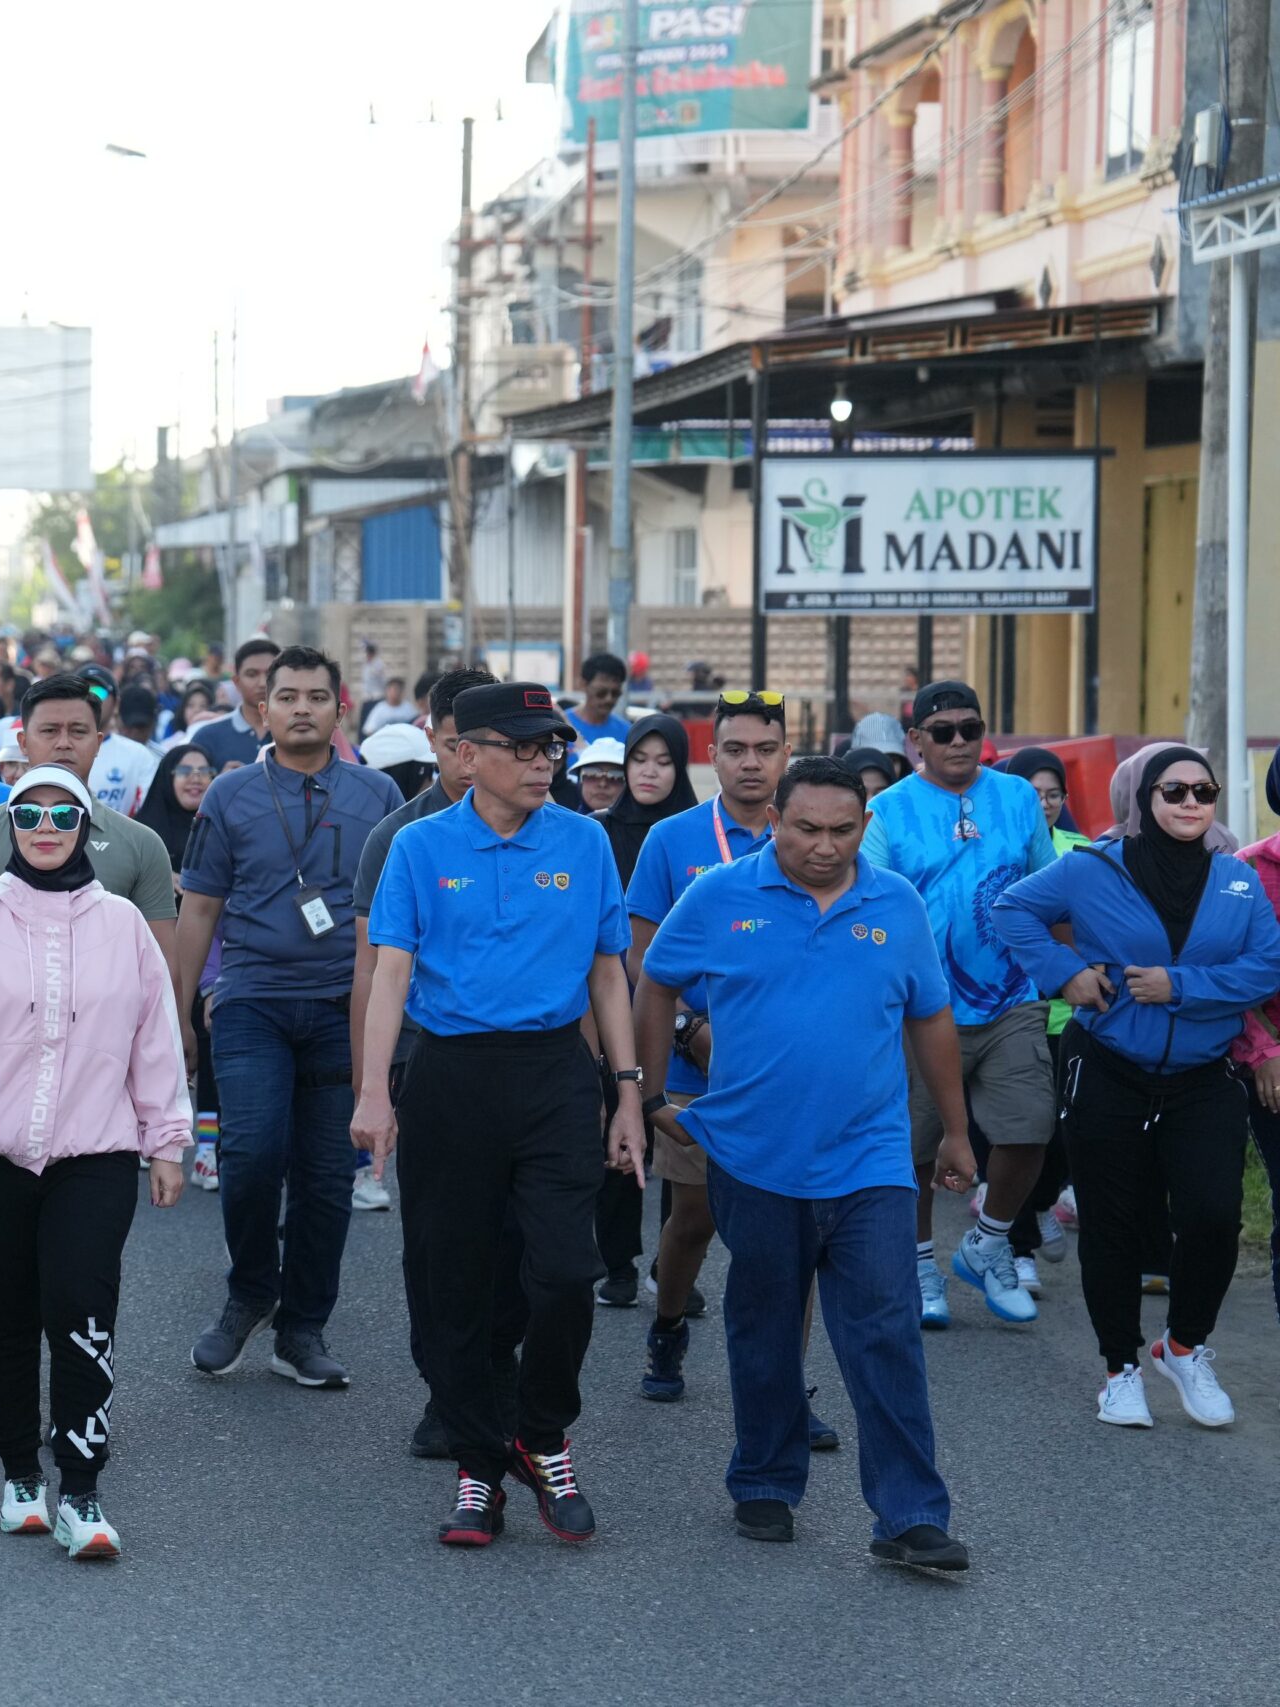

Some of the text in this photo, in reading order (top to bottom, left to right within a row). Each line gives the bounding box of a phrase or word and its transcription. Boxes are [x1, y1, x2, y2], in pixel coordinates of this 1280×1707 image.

[649, 5, 747, 41] PAS!
[904, 486, 1063, 522] APOTEK
[884, 530, 1083, 572] MADANI
[43, 952, 62, 1041] UNDER
[26, 1043, 57, 1160] ARMOUR
